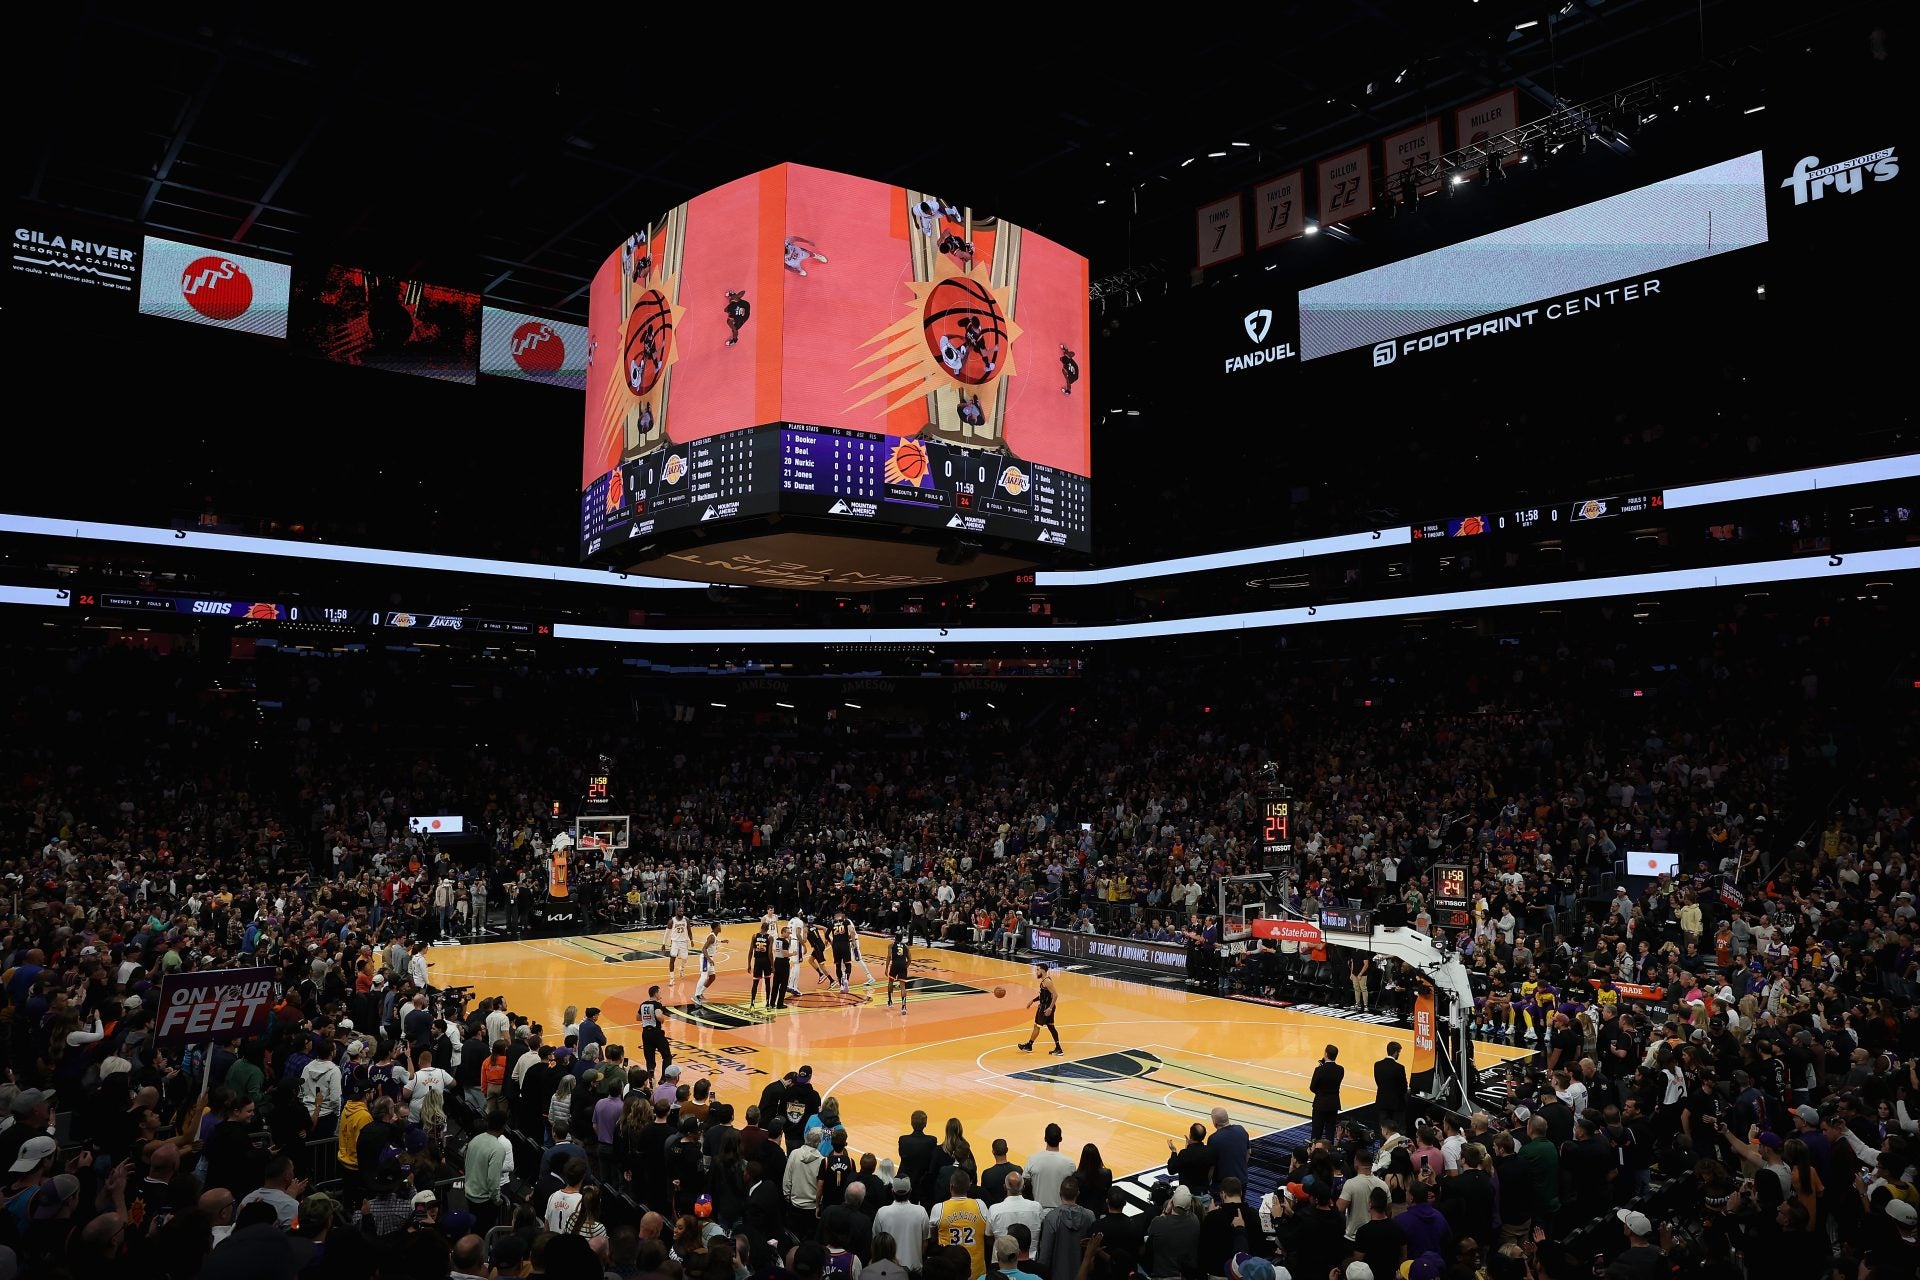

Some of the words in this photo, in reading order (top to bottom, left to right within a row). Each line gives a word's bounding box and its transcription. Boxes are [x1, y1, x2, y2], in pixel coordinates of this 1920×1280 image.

[1471, 107, 1502, 128] MILLER
[1398, 135, 1426, 155] PETTIS
[1330, 160, 1358, 180] GILLOM
[1808, 164, 1840, 179] FOOD
[1843, 149, 1889, 169] STORES
[1266, 185, 1291, 202] TAYLOR
[1329, 176, 1361, 213] 22
[1208, 209, 1230, 224] TIMMS
[1268, 200, 1291, 233] 13
[15, 228, 66, 249] GILA
[70, 239, 133, 262] RIVER
[1212, 224, 1227, 253] 7
[13, 242, 69, 259] RESORTS
[86, 257, 136, 272] CASINOS
[63, 274, 80, 282] horse
[1403, 309, 1538, 356] FOOTPRINT
[1547, 279, 1661, 319] CENTER
[1225, 343, 1295, 374] FANDUEL
[788, 423, 805, 431] PLAYER
[795, 435, 817, 444] Booker
[786, 445, 791, 453] 3
[795, 446, 809, 455] Beal
[961, 449, 969, 458] 1st
[784, 457, 792, 465] 20
[794, 458, 815, 468] Nurkic
[945, 460, 952, 478] 0
[648, 468, 653, 485] 0
[794, 470, 813, 479] Jones
[978, 466, 985, 483] 0
[783, 480, 792, 488] 35
[794, 481, 815, 491] Durant
[891, 488, 912, 496] TIMEOUTS
[955, 481, 974, 494] 11:58
[717, 501, 740, 510] MOUNTAIN
[850, 501, 877, 510] MOUNTAIN
[961, 497, 969, 506] 24
[1651, 497, 1663, 507] 24
[718, 507, 737, 515] AMERICA
[852, 507, 875, 515] AMERICA
[1621, 504, 1642, 513] TIMEOUTS
[965, 516, 986, 525] MOUNTAIN
[1499, 516, 1505, 529] 0
[1515, 509, 1539, 523] 11:58
[1551, 510, 1558, 522] 0
[965, 521, 985, 529] AMERICA
[1413, 529, 1423, 539] 24
[1015, 575, 1034, 583] 8:05
[80, 595, 94, 605] 24
[290, 608, 298, 620] 0
[324, 608, 348, 619] 11:58
[372, 613, 379, 625] 0
[427, 616, 463, 630] LAKERS
[538, 626, 549, 634] 24
[736, 679, 790, 693] JAMESON
[840, 679, 895, 694] JAMESON
[952, 680, 1008, 695] JAMESON
[590, 776, 608, 785] 11:58
[589, 784, 606, 797] 24
[1267, 803, 1288, 816] 11:58
[1266, 816, 1286, 840] 24
[1442, 870, 1464, 881] 11:58
[1444, 881, 1460, 895] 24
[1327, 916, 1337, 926] NBA
[1337, 917, 1347, 928] CUP
[833, 925, 845, 935] 20
[755, 941, 767, 952] 35
[1038, 936, 1050, 950] NBA
[1049, 937, 1061, 953] CUP
[897, 947, 903, 956] 3
[1088, 941, 1096, 954] 30
[1097, 942, 1118, 958] TEAMS.
[1118, 947, 1123, 958] 8
[1122, 947, 1149, 963] ADVANCE.
[1151, 950, 1154, 963] 1
[171, 986, 208, 1006] ON
[158, 997, 267, 1037] FEET
[1417, 1011, 1430, 1024] GET
[1418, 1023, 1430, 1037] THE
[1421, 1036, 1433, 1051] App
[830, 1163, 848, 1172] BOOKER
[836, 1171, 842, 1187] 1
[559, 1211, 563, 1229] 1
[946, 1210, 979, 1225] JOHNSON
[950, 1227, 976, 1246] 32
